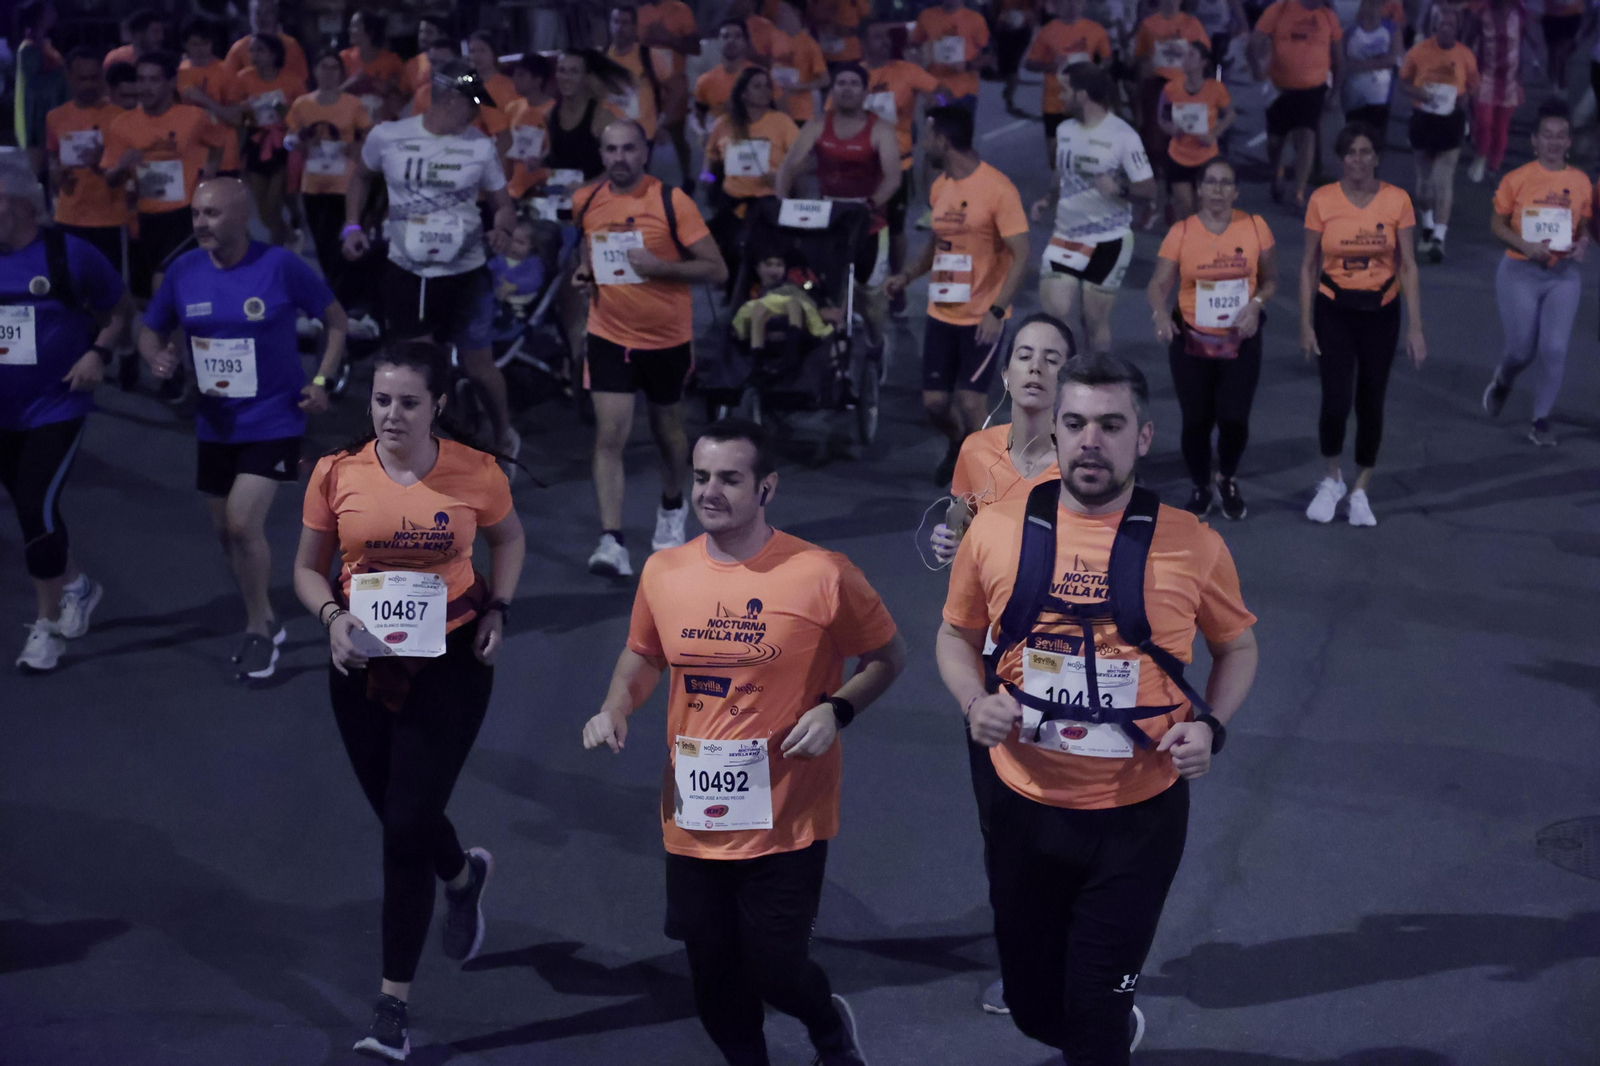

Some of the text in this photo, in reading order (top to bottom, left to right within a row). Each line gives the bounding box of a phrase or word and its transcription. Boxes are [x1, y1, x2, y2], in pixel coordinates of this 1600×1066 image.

[204, 358, 243, 373] 17393
[393, 531, 455, 541] NOCTURNA
[365, 540, 420, 550] SEVILLA
[371, 600, 429, 620] 10487
[707, 618, 767, 632] NOCTURNA
[681, 628, 732, 641] SEVILLA
[1046, 686, 1113, 708] 1043
[689, 770, 749, 792] 10492
